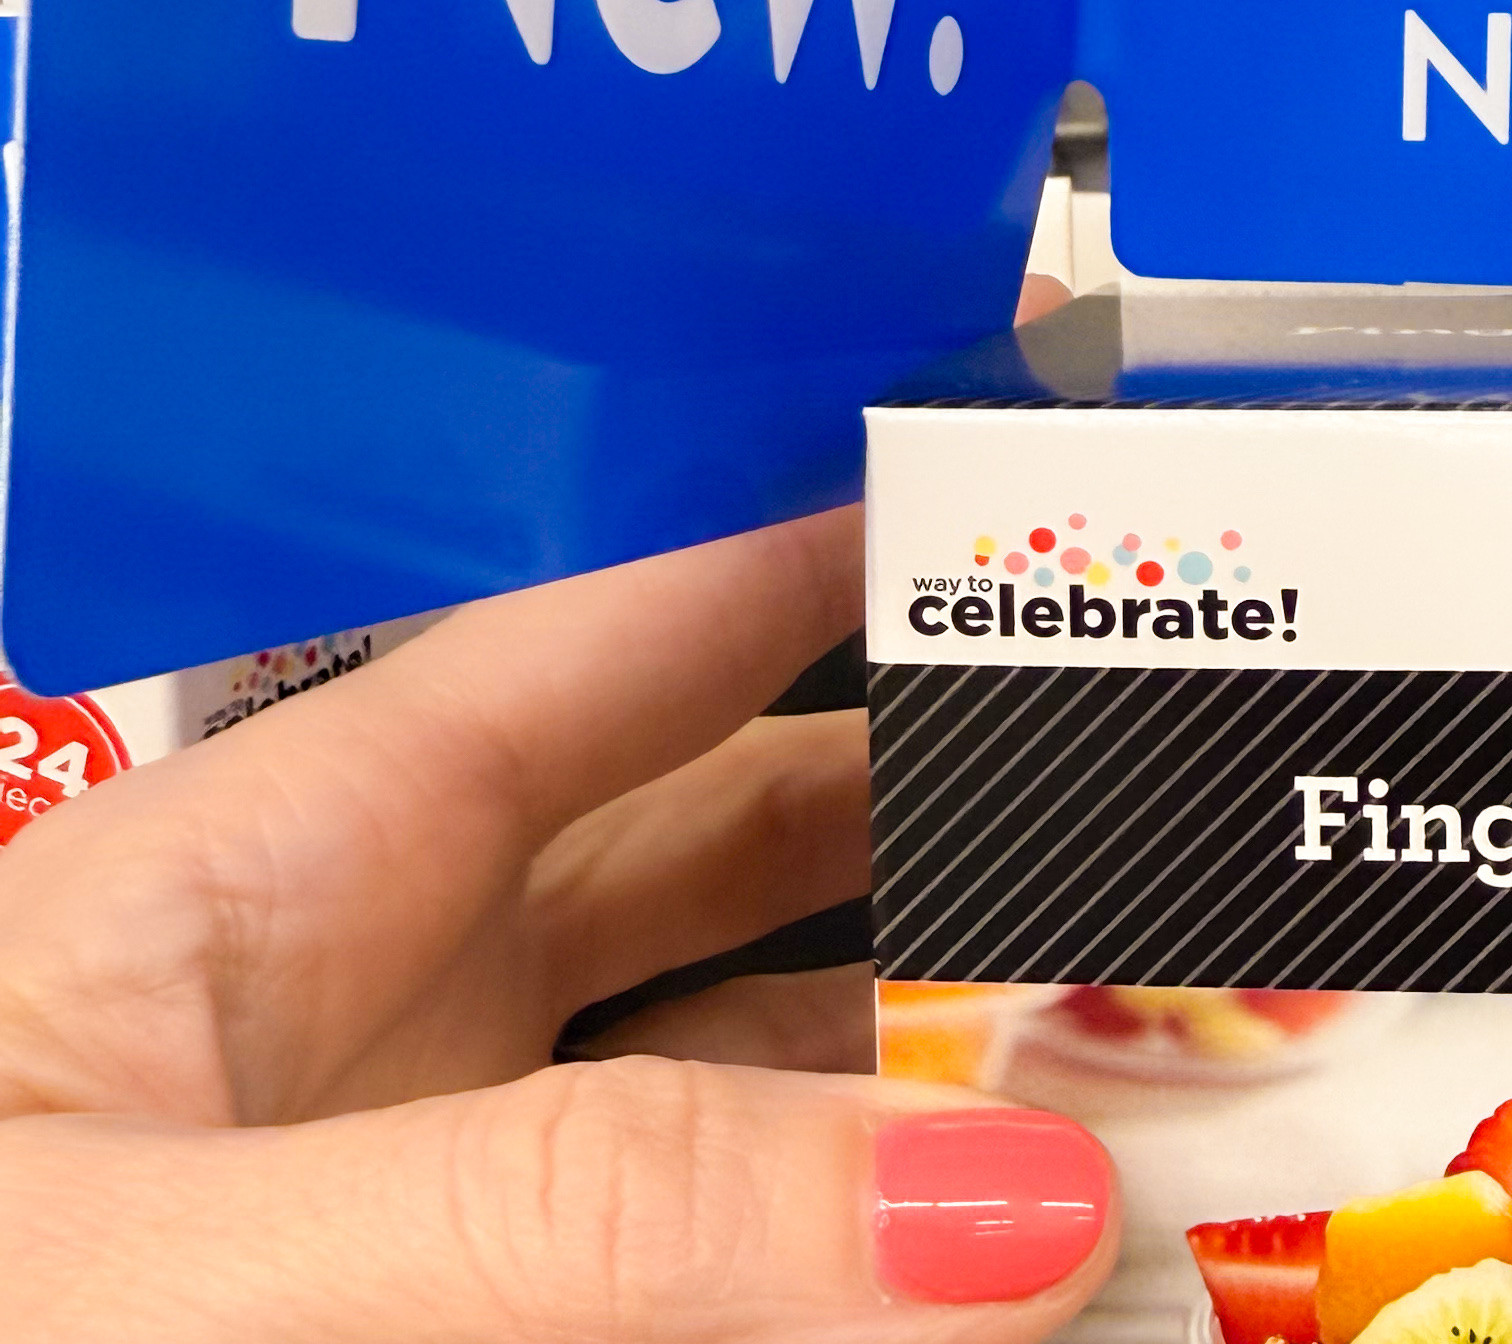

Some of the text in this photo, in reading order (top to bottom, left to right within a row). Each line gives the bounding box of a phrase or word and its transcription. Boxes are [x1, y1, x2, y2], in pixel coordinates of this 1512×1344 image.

[908, 583, 1299, 643] celebrate!
[912, 575, 994, 596] way to
[0, 716, 89, 798] 24
